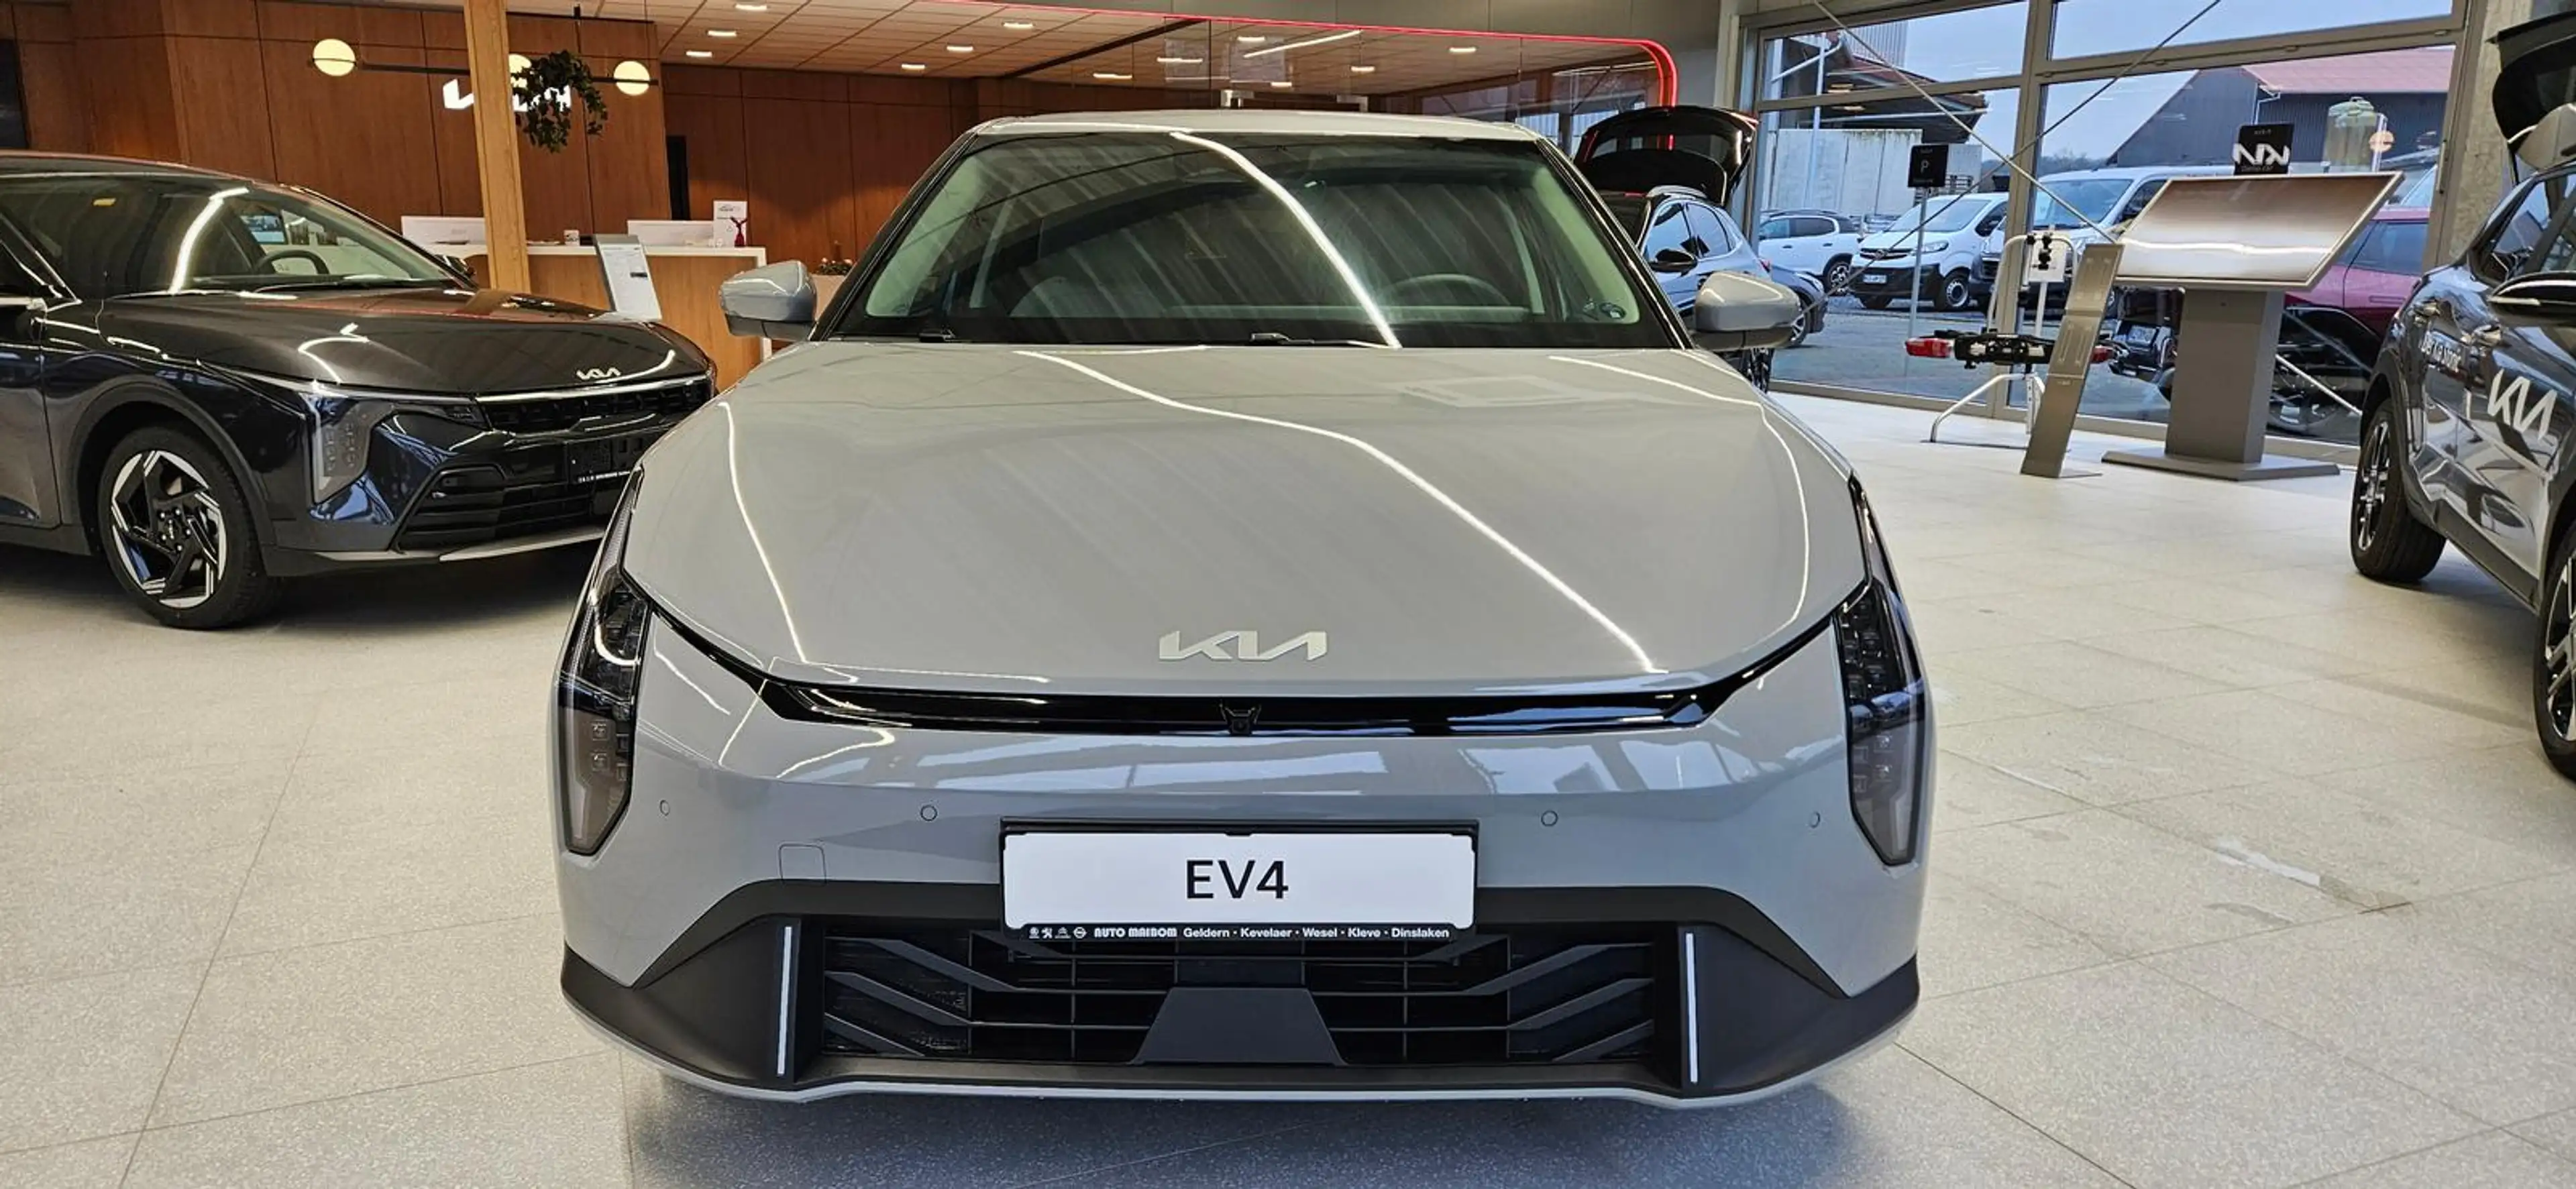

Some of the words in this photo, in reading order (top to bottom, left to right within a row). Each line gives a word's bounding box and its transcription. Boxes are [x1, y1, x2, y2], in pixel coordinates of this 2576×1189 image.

[2487, 368, 2557, 441] KIA
[1159, 630, 1328, 661] KIA
[1186, 860, 1289, 899] EV4
[1094, 927, 1125, 938] AUTO
[1183, 926, 1230, 938] Geldern
[1240, 927, 1291, 938] Kevelaer
[1303, 927, 1337, 938] Wesel
[1348, 927, 1381, 938] Kleve
[1391, 927, 1450, 938] Dinslaken
